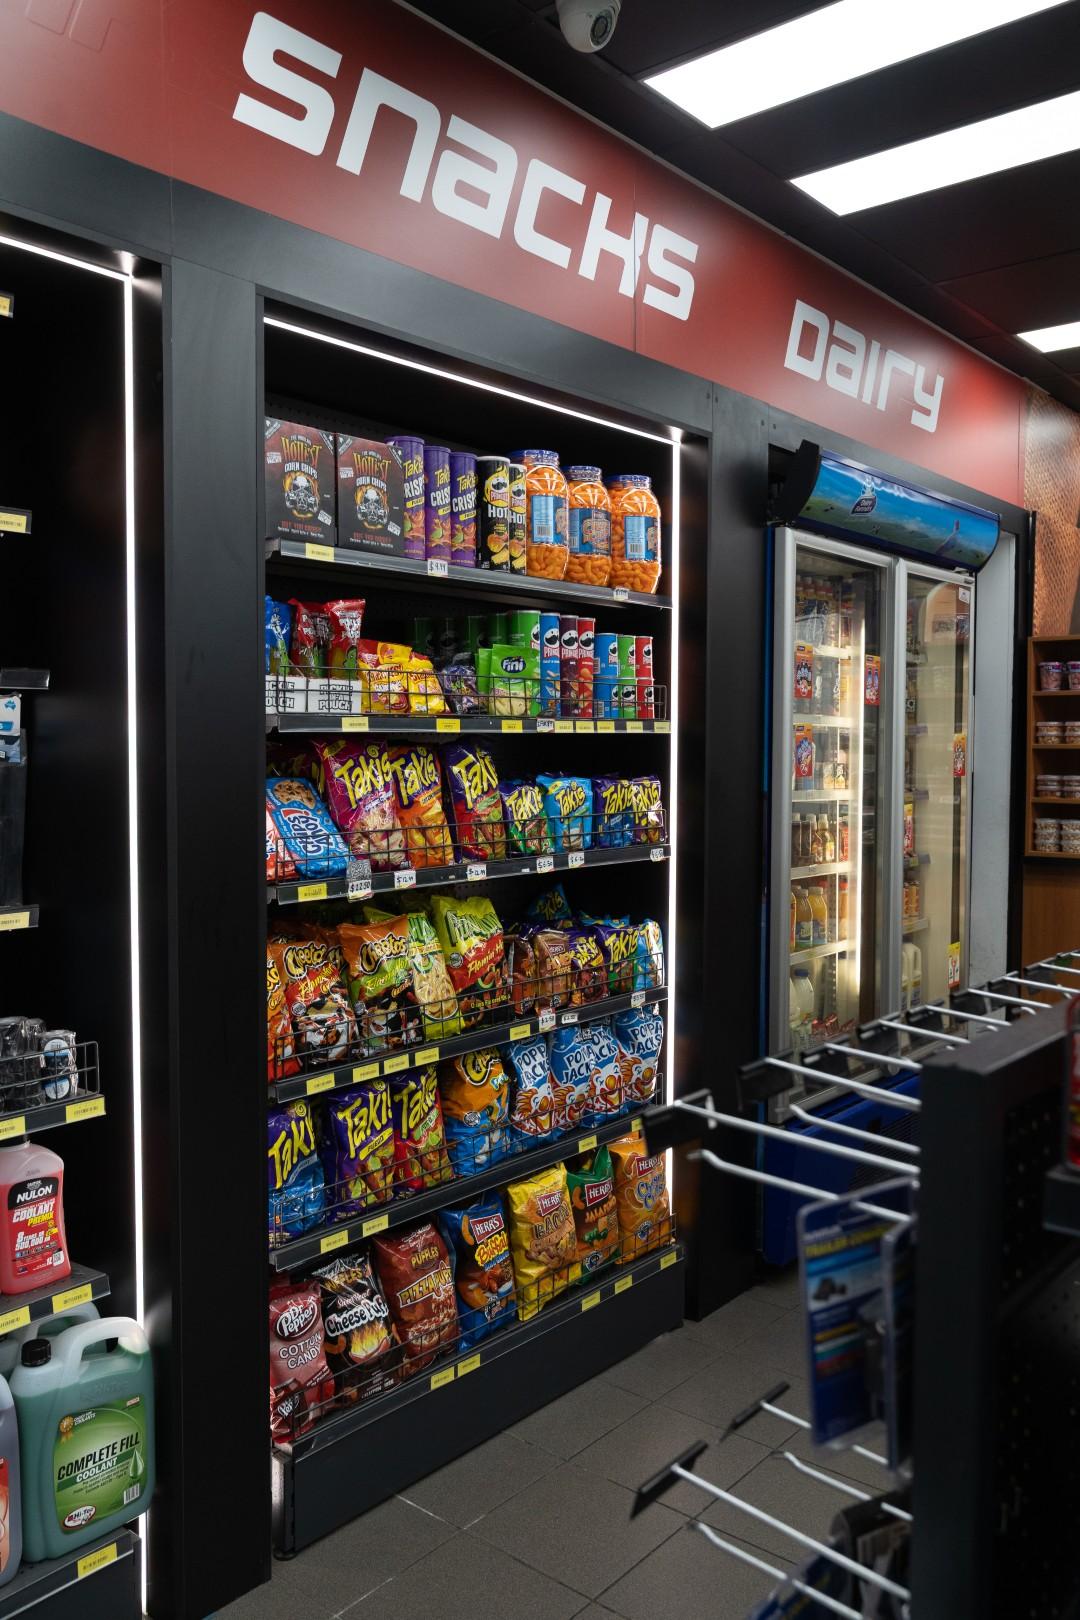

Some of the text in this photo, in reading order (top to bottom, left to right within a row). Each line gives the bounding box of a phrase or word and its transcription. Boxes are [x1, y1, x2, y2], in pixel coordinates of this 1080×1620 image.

[284, 461, 318, 479] CORN CHIPS
[356, 476, 387, 491] CORN CHIPS
[319, 700, 352, 710] POUCH
[335, 744, 394, 810] Takis
[391, 746, 438, 807] Takis
[555, 781, 586, 822] Takis
[603, 780, 634, 824] Takis
[288, 814, 323, 855] CHIPS
[361, 933, 408, 975] Cheetos
[604, 930, 638, 971] Takis
[629, 1034, 662, 1055] JACKS
[16, 1184, 53, 1204] NULON
[12, 1198, 55, 1223] COOLANT
[475, 1217, 500, 1233] HERR'S
[411, 1246, 438, 1266] PUFFLES
[399, 1275, 435, 1305] PIZZA
[281, 1305, 315, 1337] Pepper
[290, 1305, 304, 1321] Dr
[326, 1310, 367, 1334] Cheese
[280, 1332, 322, 1359] COTTON
[287, 1345, 321, 1369] CANDY
[57, 1442, 118, 1481] COMPLETE
[119, 1431, 140, 1453] FILL
[76, 1456, 118, 1483] COOLANT
